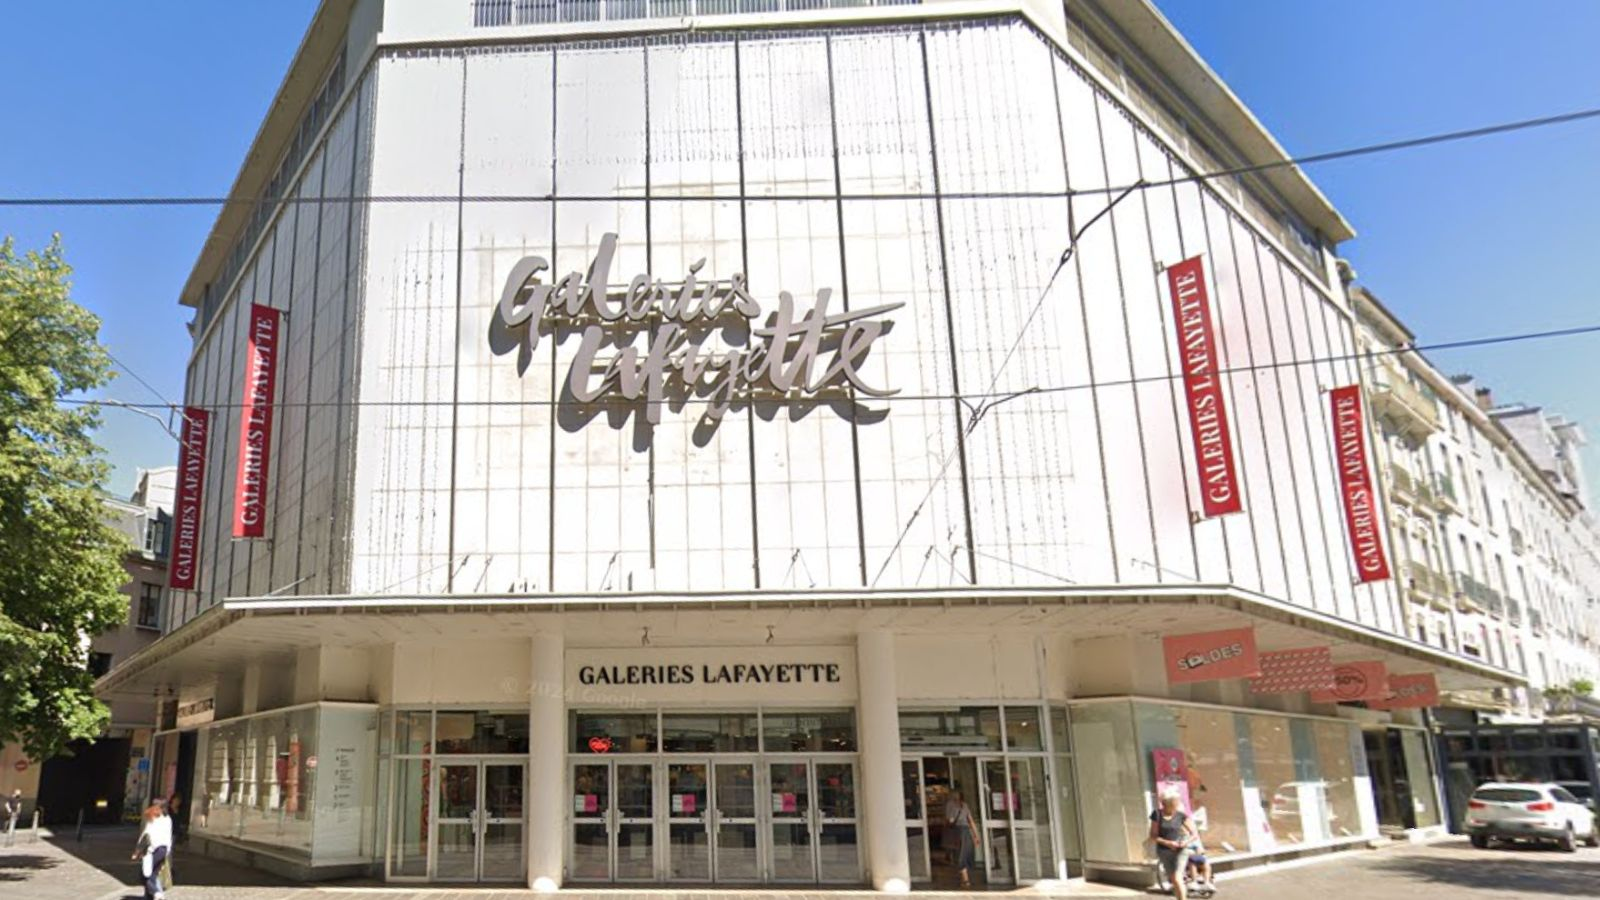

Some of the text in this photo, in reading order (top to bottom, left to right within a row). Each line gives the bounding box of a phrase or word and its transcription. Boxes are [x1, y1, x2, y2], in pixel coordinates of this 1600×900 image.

[240, 317, 272, 525] GALERIES LAFAYETTE
[571, 288, 906, 424] Lafayette
[1176, 269, 1231, 503] GALERIES LAFAYETTE
[176, 419, 204, 580] GALERIES LAFAYETTE
[1337, 396, 1381, 571] GALERIES LAFAYETTE
[579, 664, 841, 686] GALERIES LAFAYETTE
